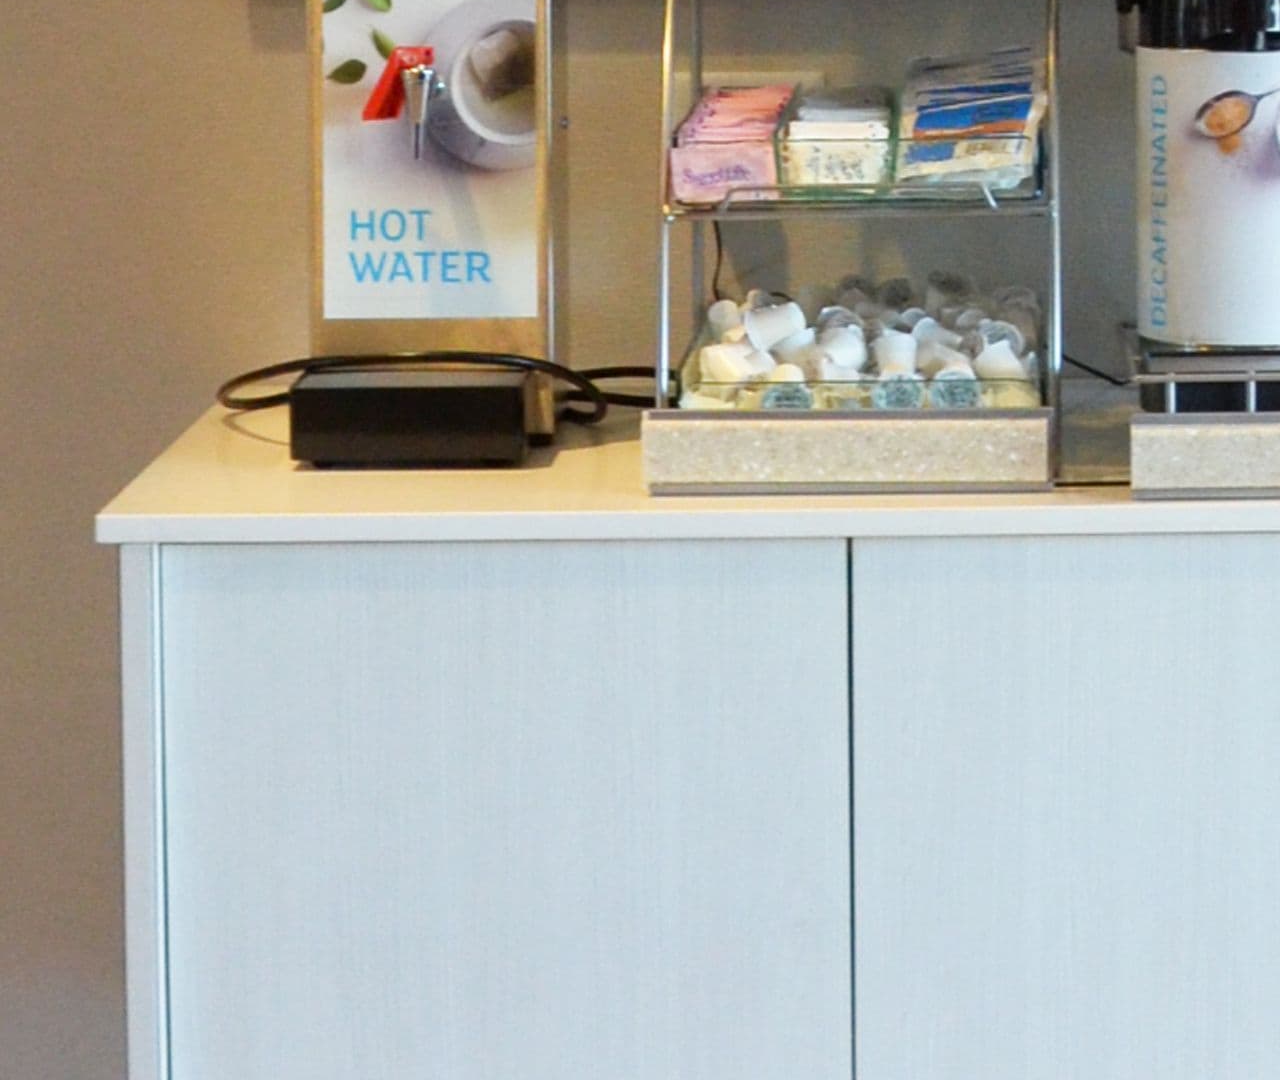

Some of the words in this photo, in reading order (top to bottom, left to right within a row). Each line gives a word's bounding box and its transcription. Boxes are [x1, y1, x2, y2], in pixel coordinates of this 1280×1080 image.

[1151, 75, 1168, 327] DECAFFEINATED
[350, 210, 432, 242] HOT
[349, 251, 491, 284] WATER
